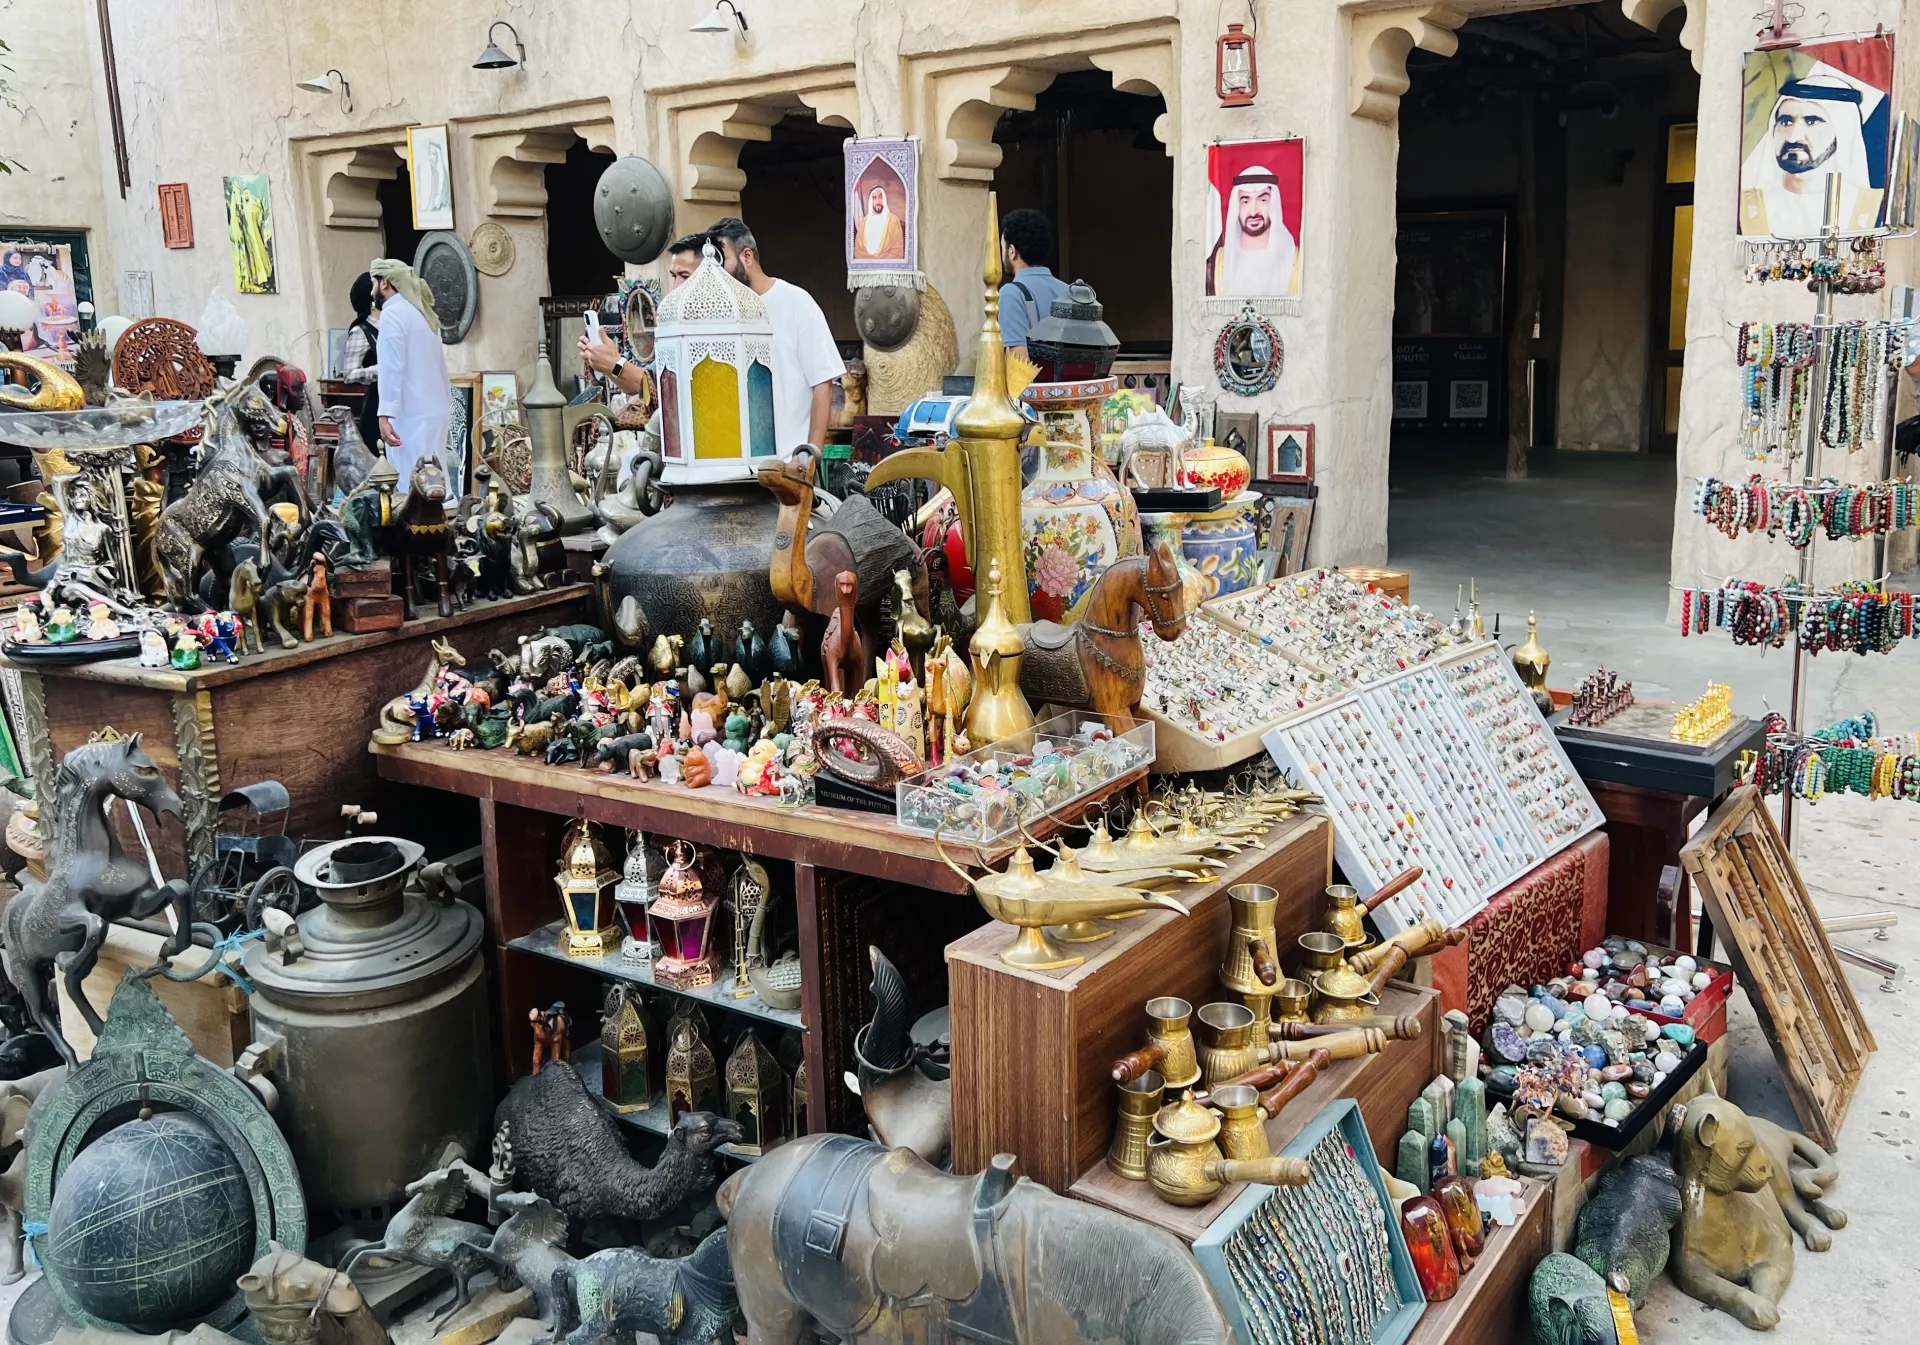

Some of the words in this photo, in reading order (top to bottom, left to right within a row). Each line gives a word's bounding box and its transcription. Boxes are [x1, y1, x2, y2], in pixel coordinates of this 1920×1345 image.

[1396, 345, 1416, 353] GOT
[1417, 345, 1424, 353] A
[820, 790, 846, 802] MUSEUM
[855, 798, 867, 806] THE
[868, 801, 891, 811] FUTURE
